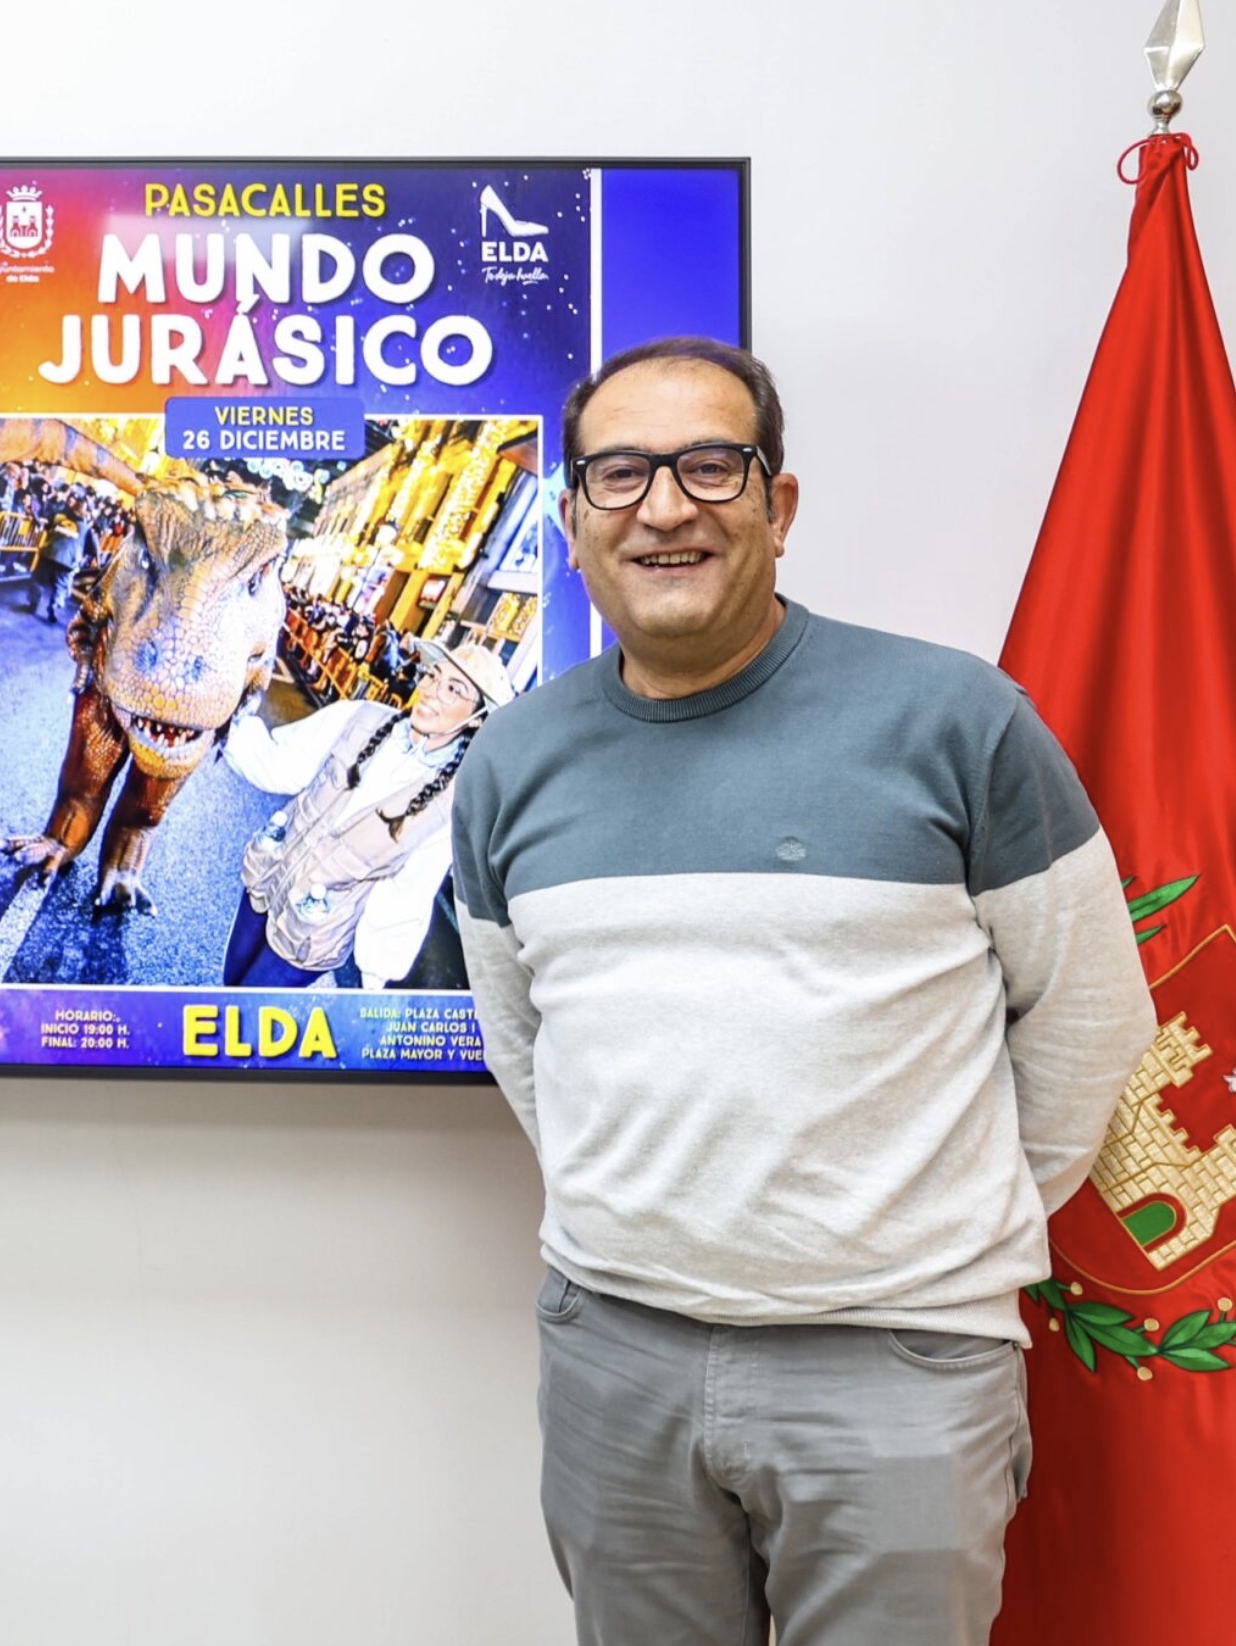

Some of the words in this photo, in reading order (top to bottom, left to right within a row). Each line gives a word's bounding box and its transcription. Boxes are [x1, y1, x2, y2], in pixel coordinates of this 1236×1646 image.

[144, 182, 386, 218] PASACALLES
[481, 241, 549, 263] ELDA
[97, 232, 435, 304] MUNDO
[38, 294, 494, 386] JURÁSICO
[214, 405, 314, 427] VIERNES
[182, 430, 211, 451] 26
[219, 430, 346, 451] DICIEMBRE
[55, 1009, 117, 1022] HORARIO:
[359, 1006, 400, 1019] SALIDA:
[405, 1007, 439, 1020] PLAZA
[40, 1022, 80, 1035] INICIO
[83, 1023, 114, 1036] 19:00
[117, 1024, 131, 1036] H.
[183, 1004, 338, 1059] ELDA
[387, 1021, 417, 1033] JUAN
[420, 1021, 467, 1034] CARLOS
[40, 1035, 77, 1049] FINAL:
[80, 1036, 114, 1049] 20:00
[117, 1037, 130, 1049] H.
[379, 1034, 446, 1047] ANTONINO
[450, 1035, 482, 1048] VERA
[361, 1047, 397, 1060] PLAZA
[400, 1048, 443, 1061] MAYOR
[447, 1048, 456, 1061] Y
